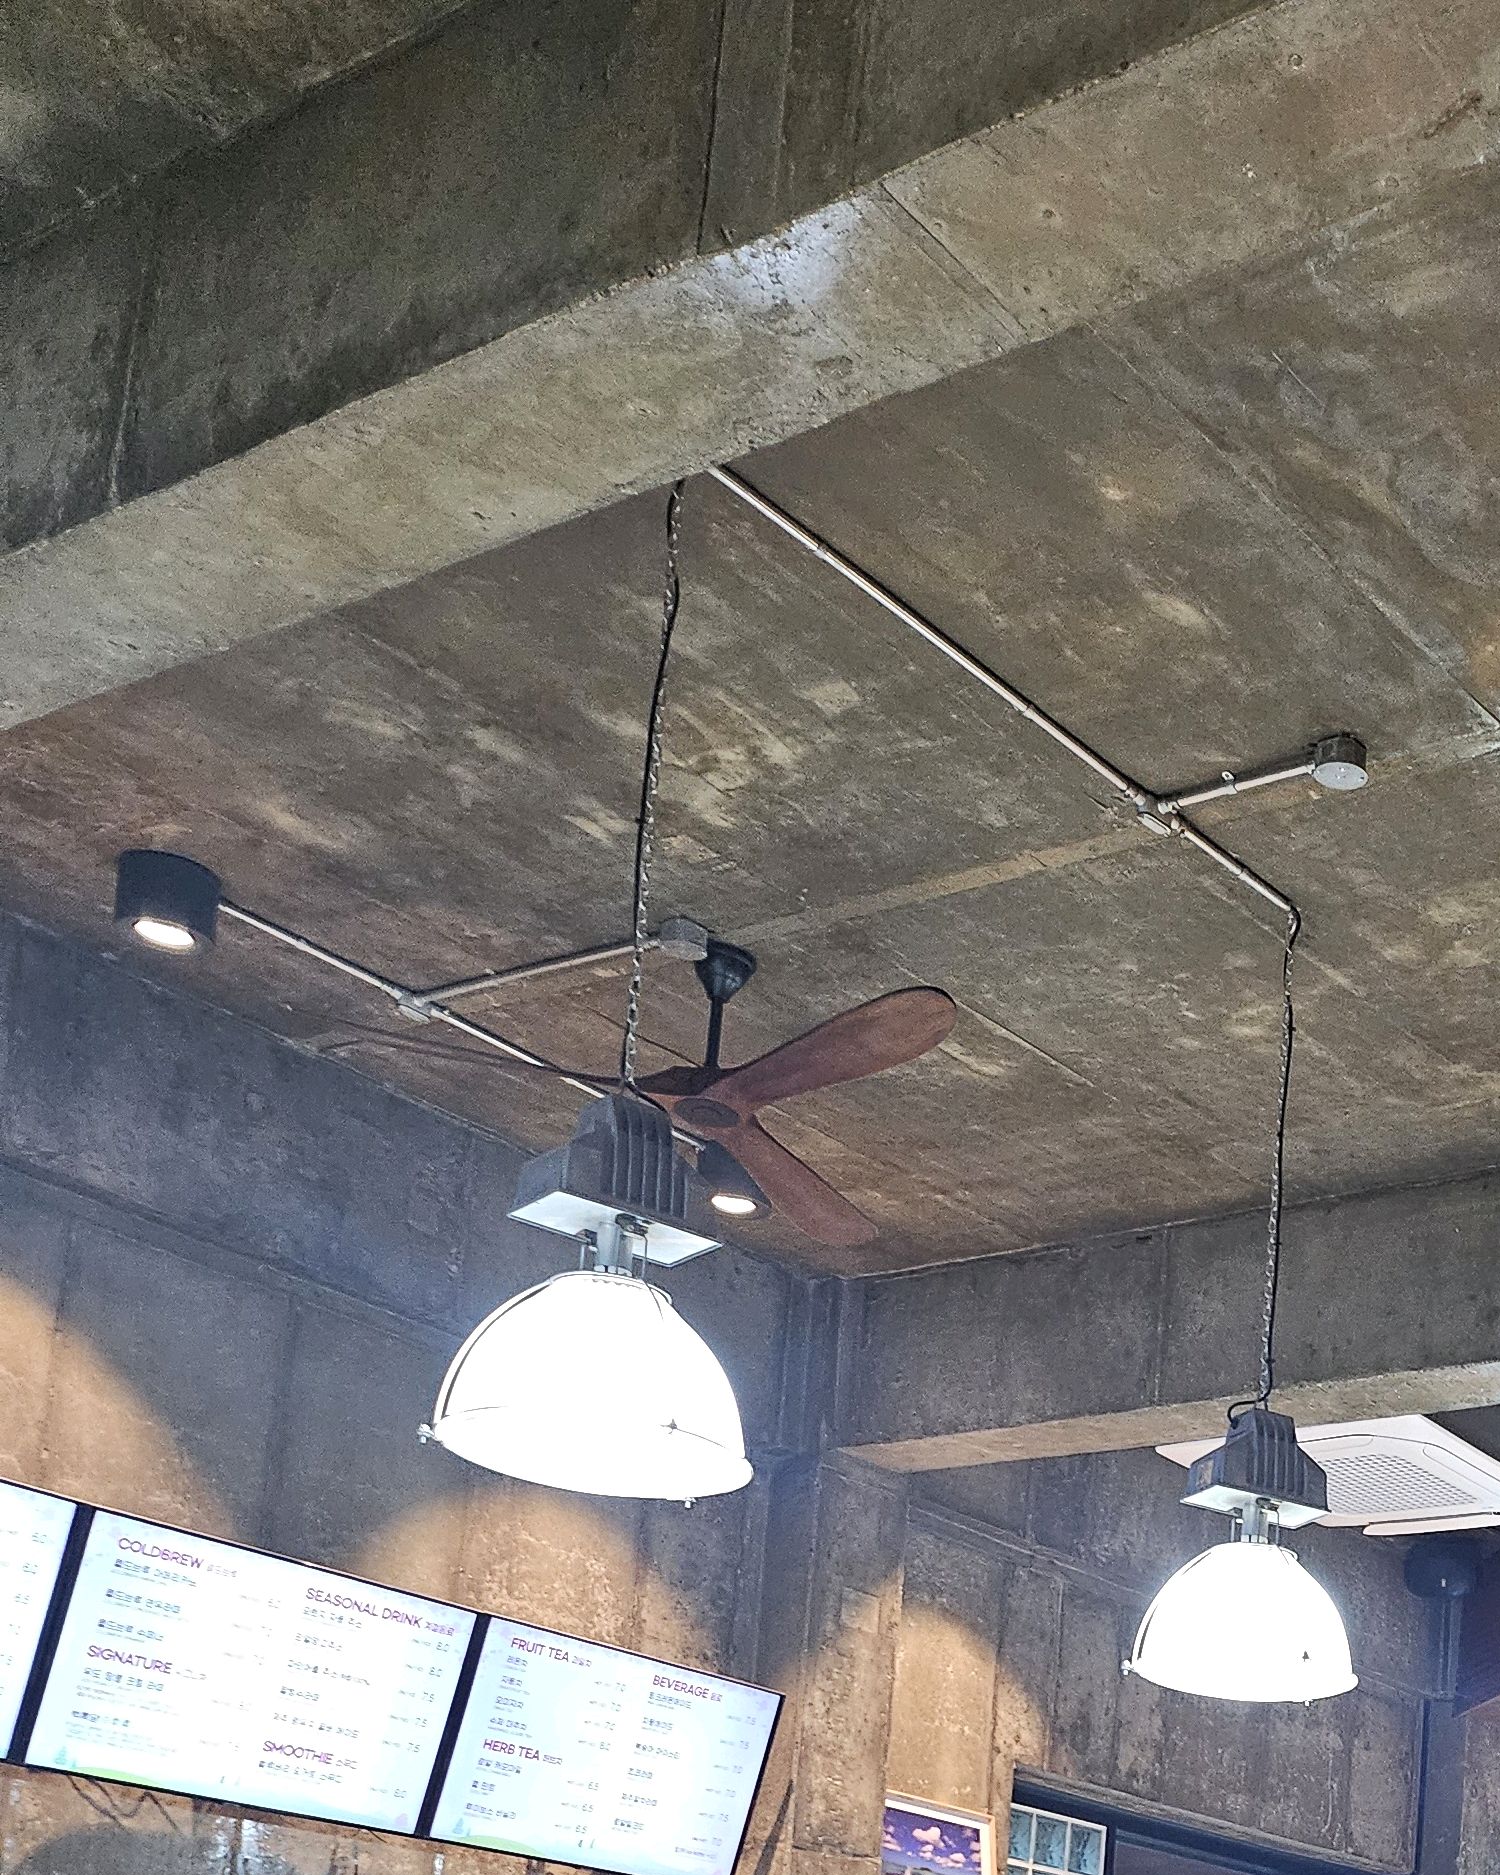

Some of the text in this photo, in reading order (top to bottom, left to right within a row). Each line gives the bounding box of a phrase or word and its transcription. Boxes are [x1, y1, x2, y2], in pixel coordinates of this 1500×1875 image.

[117, 1536, 204, 1569] COLDBREW
[305, 1587, 380, 1616] SEASONAL
[381, 1607, 422, 1628] DRINK
[86, 1644, 173, 1674] SIGNATURE
[510, 1636, 545, 1655] FRUIT
[547, 1647, 570, 1662] TEA
[652, 1674, 709, 1698] BEVERAGE
[262, 1740, 333, 1764] SMOOTHIE
[482, 1738, 516, 1755] HERB
[516, 1745, 541, 1760] TEA
